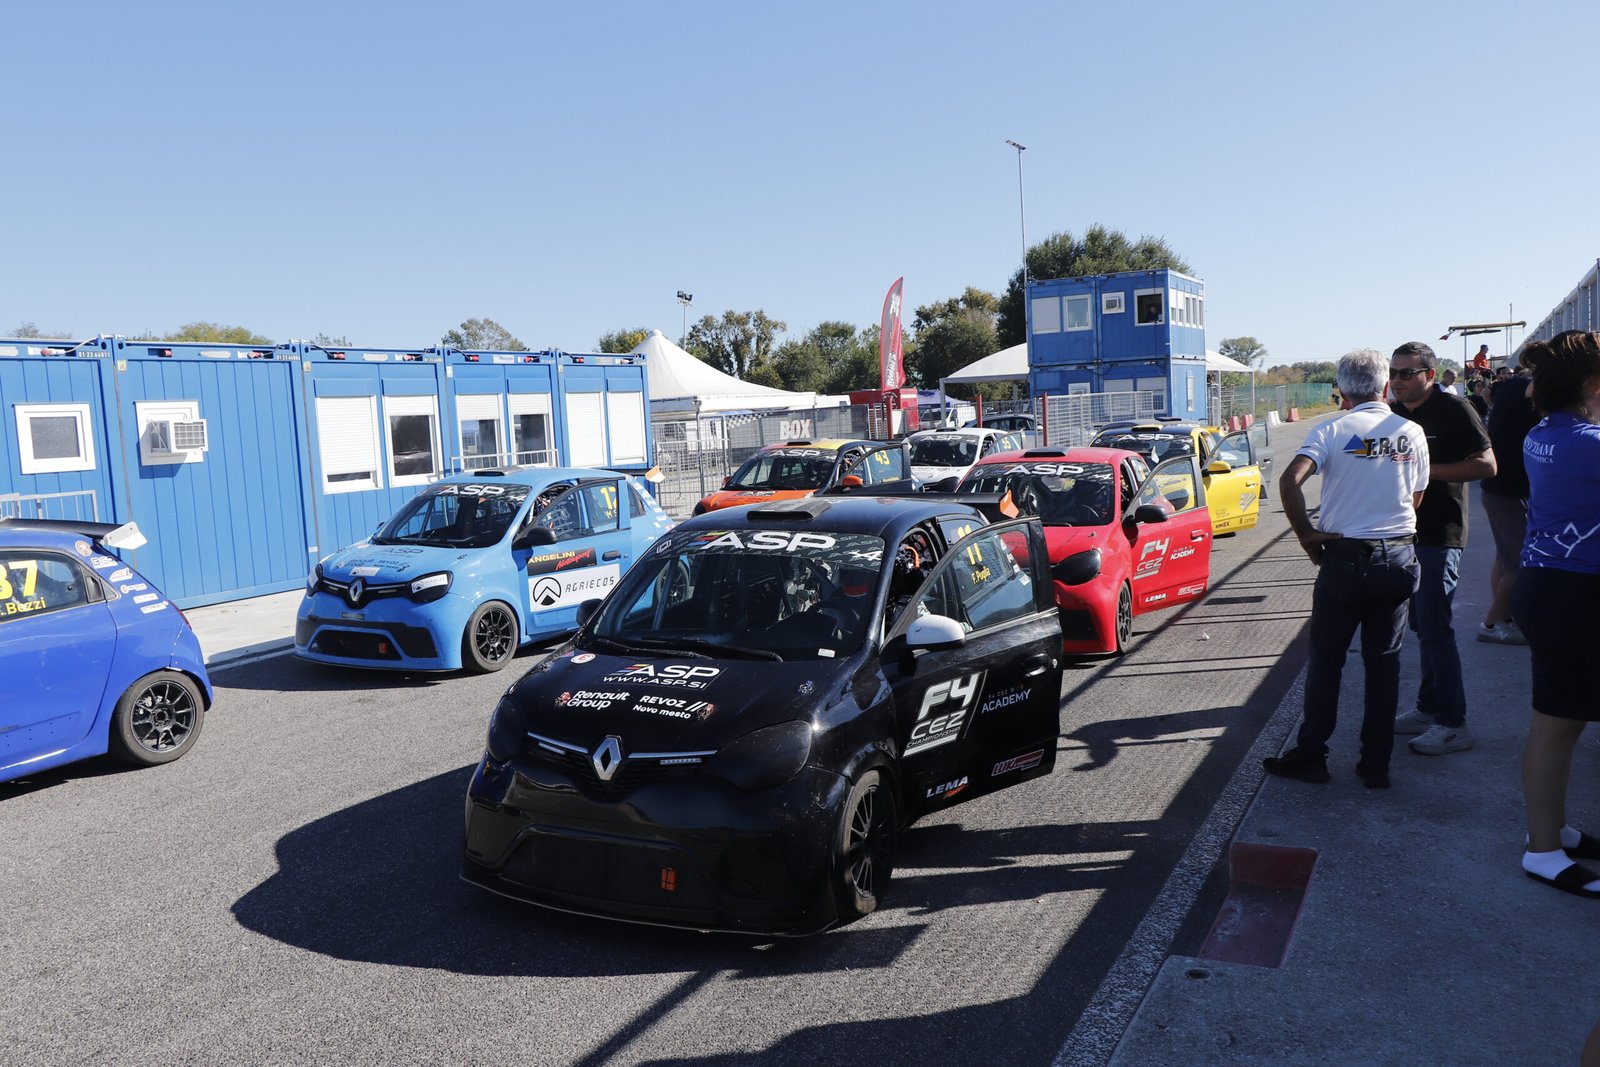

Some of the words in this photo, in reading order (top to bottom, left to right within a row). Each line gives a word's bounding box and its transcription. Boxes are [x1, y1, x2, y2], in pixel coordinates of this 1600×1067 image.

[780, 419, 812, 440] BOX
[1118, 433, 1174, 441] ASP
[771, 449, 821, 457] ASP
[1004, 464, 1084, 476] ASP
[437, 485, 505, 496] ASP
[701, 531, 836, 552] ASP
[1140, 537, 1170, 561] F4
[528, 551, 576, 564] ANGELINI
[1170, 548, 1196, 560] ACADEMY
[1136, 557, 1164, 572] CEZ
[565, 576, 615, 593] AGRIECOS
[1145, 593, 1167, 603] LEMA
[625, 663, 720, 679] ASP
[573, 690, 631, 701] Renault
[639, 695, 687, 708] REVOZ
[917, 671, 983, 721] F4
[981, 688, 1032, 714] ACADEMY
[566, 699, 612, 711] Group
[633, 704, 658, 714] Novo
[659, 709, 692, 719] mesto
[911, 709, 967, 740] CEZ
[926, 775, 968, 798] LEMA
